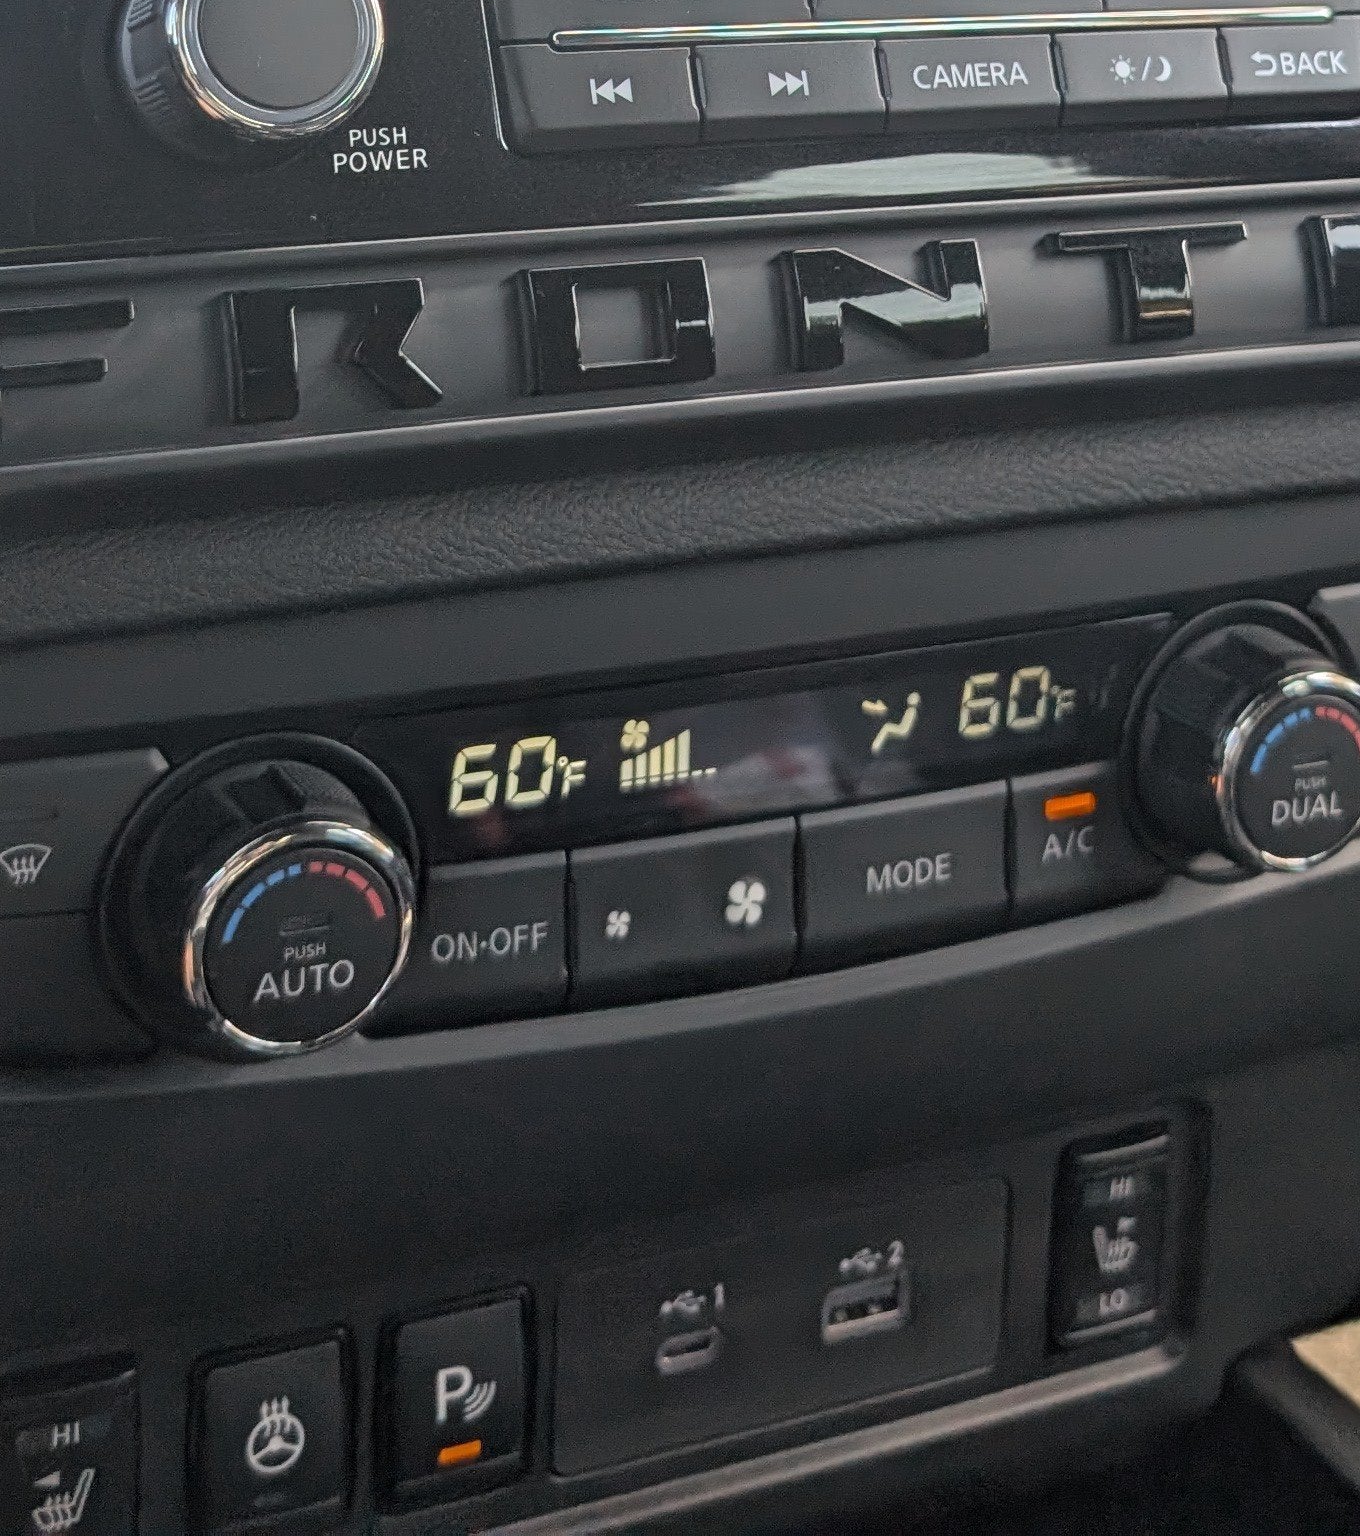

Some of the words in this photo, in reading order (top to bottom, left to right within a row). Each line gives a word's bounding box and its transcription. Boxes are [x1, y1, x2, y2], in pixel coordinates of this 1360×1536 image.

[912, 61, 1029, 91] CAMERA
[1281, 50, 1347, 77] BACK
[348, 126, 408, 148] PUSH
[332, 147, 429, 175] POWER
[1271, 789, 1343, 825] DUAL
[1041, 825, 1095, 862] A/C
[865, 853, 952, 894] MODE
[283, 941, 327, 962] PUSH
[252, 959, 355, 1003] AUTO
[1109, 1175, 1135, 1201] HI
[1099, 1287, 1131, 1315] LO
[49, 1419, 81, 1451] HI
